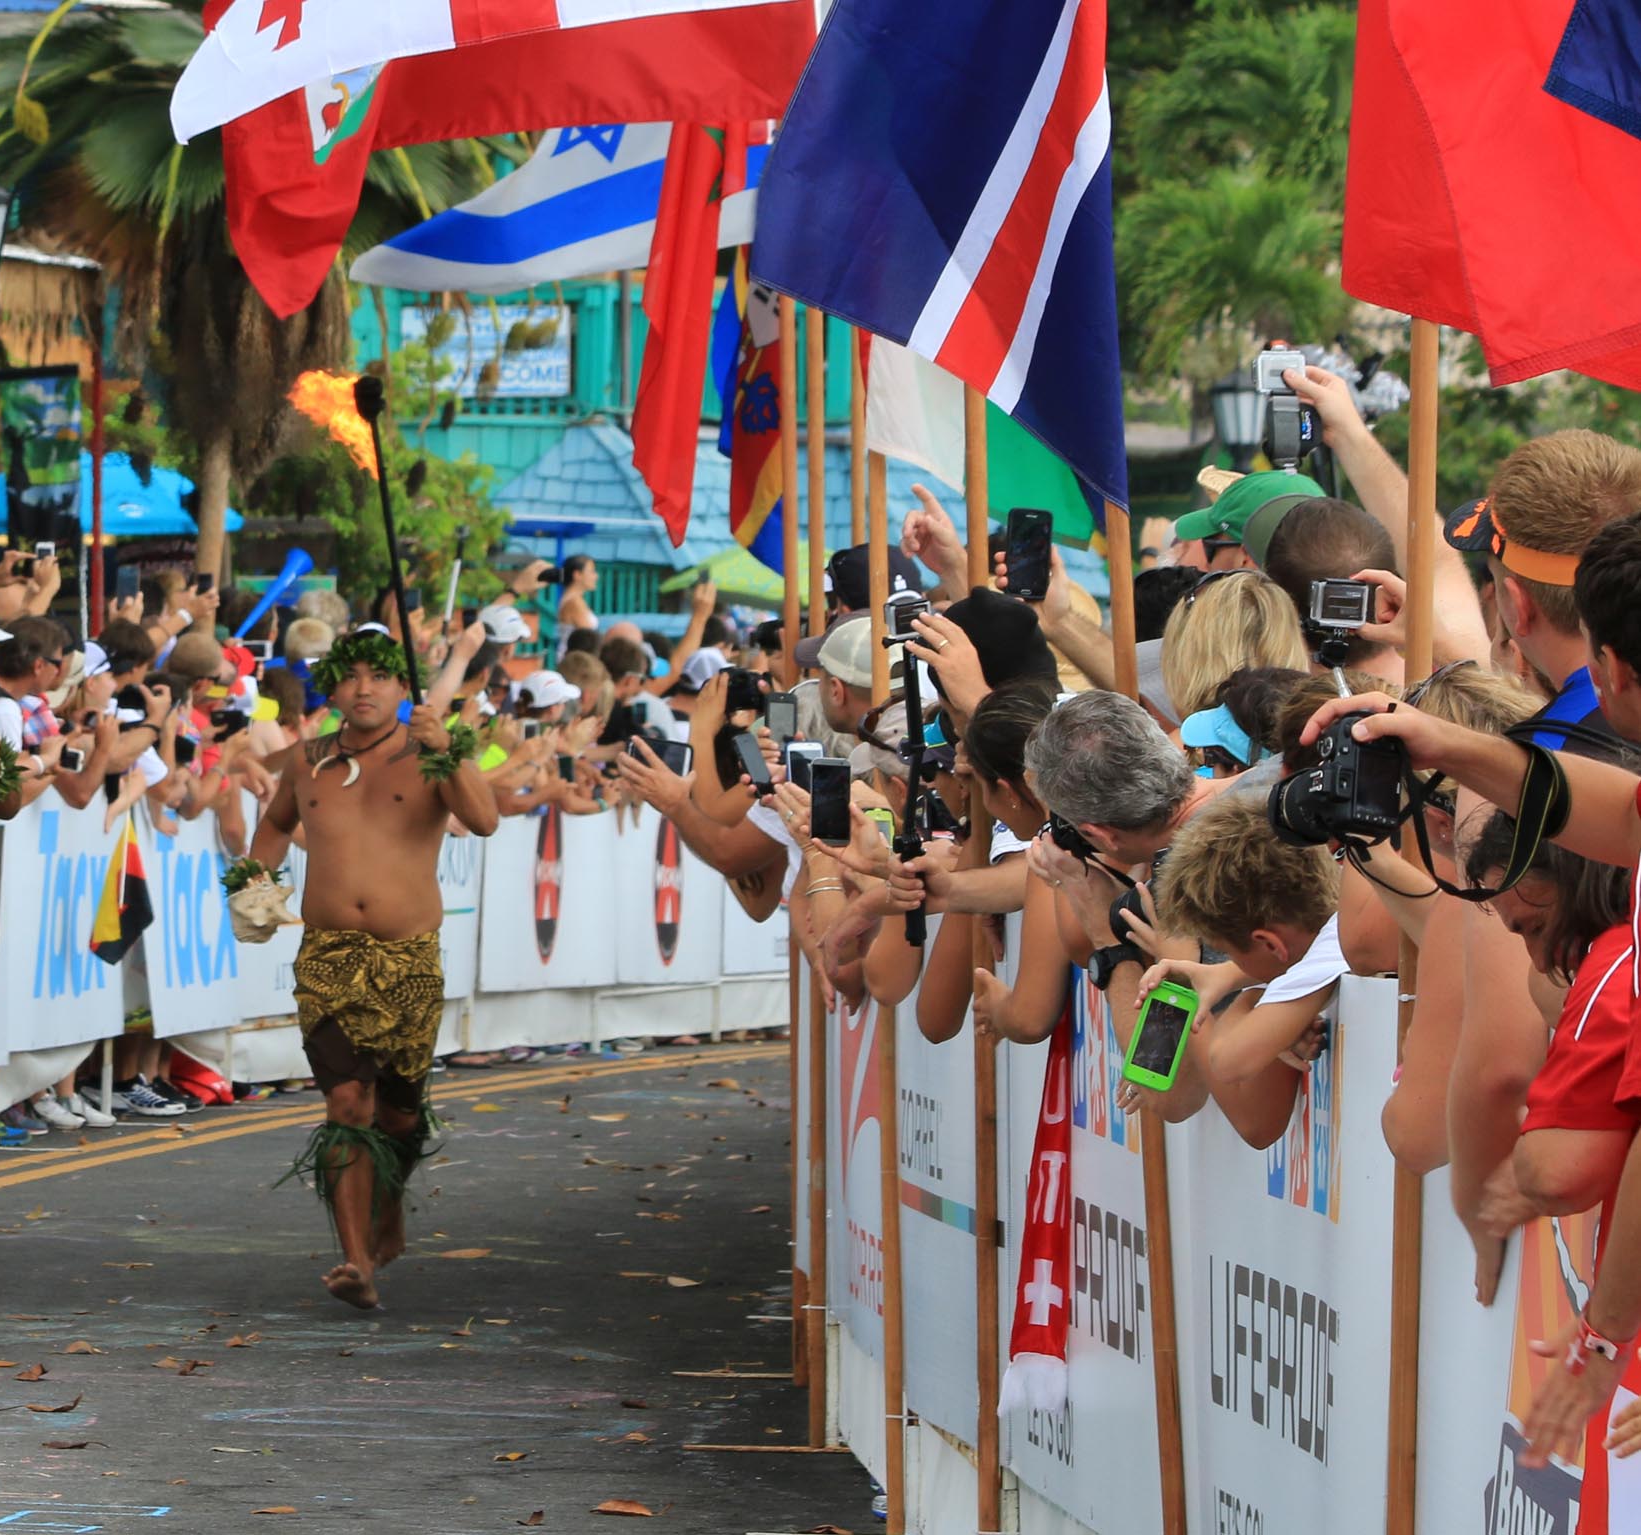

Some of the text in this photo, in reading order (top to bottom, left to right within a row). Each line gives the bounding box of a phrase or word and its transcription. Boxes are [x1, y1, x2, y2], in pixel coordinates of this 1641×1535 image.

[449, 365, 567, 384] WECOME
[33, 810, 108, 999] Tacx
[155, 810, 238, 988] Tacx
[848, 1218, 884, 1316] ZORRE
[1069, 1196, 1146, 1365] PROOF
[1209, 1254, 1337, 1468] LIFEPROOF
